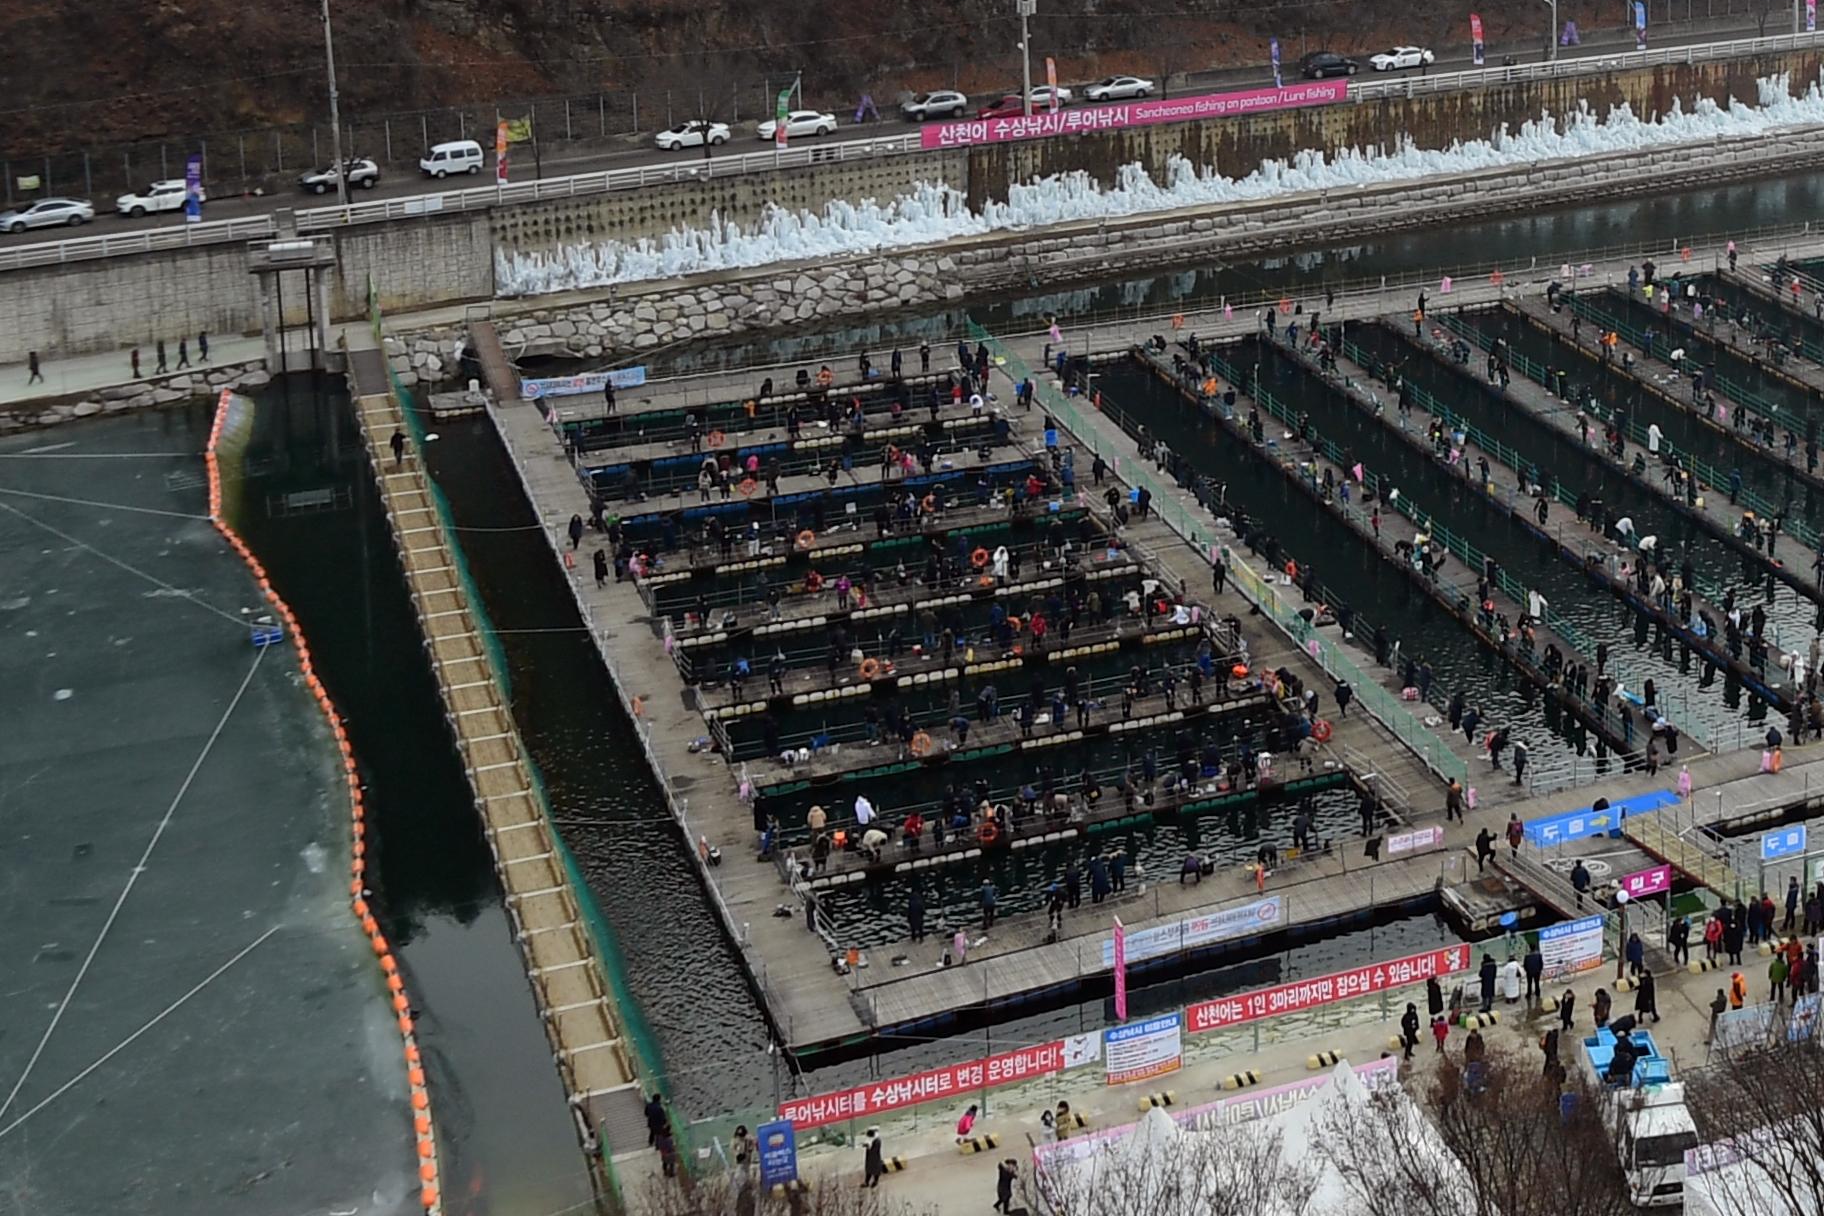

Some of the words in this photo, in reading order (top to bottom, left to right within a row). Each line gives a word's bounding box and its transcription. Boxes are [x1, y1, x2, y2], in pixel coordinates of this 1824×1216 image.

[938, 122, 988, 145] 산천어
[993, 105, 1130, 138] 수상낚시/루어낚시
[1195, 100, 1225, 113] fishing
[1227, 98, 1239, 109] on
[1240, 94, 1277, 110] pontoon
[1306, 86, 1335, 101] fishing
[1196, 1001, 1243, 1028] 산천어는
[1247, 995, 1266, 1017] 1인
[1269, 982, 1333, 1011] 3마리까지만
[1336, 973, 1370, 997] 잡으실
[1373, 968, 1386, 988] 수
[1388, 957, 1436, 984] 있습니다!
[870, 1073, 953, 1107] 수상낚시터로
[956, 1065, 984, 1087] 변경
[988, 1045, 1058, 1081] 운영합니다!
